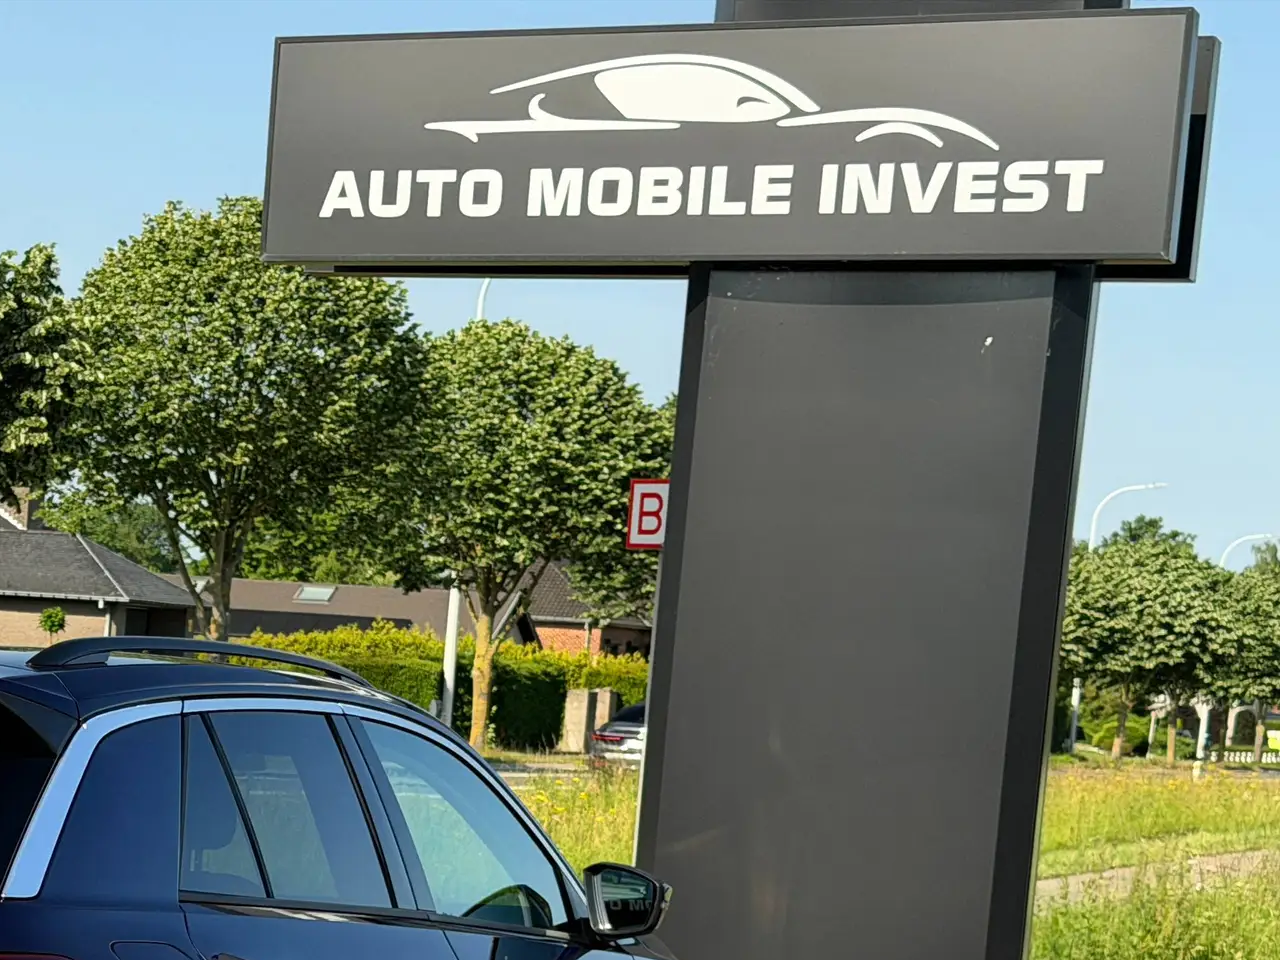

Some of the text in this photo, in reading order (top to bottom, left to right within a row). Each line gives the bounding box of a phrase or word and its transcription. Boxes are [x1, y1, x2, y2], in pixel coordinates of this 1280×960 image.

[319, 159, 1105, 218] AUTO MOBILE INVEST
